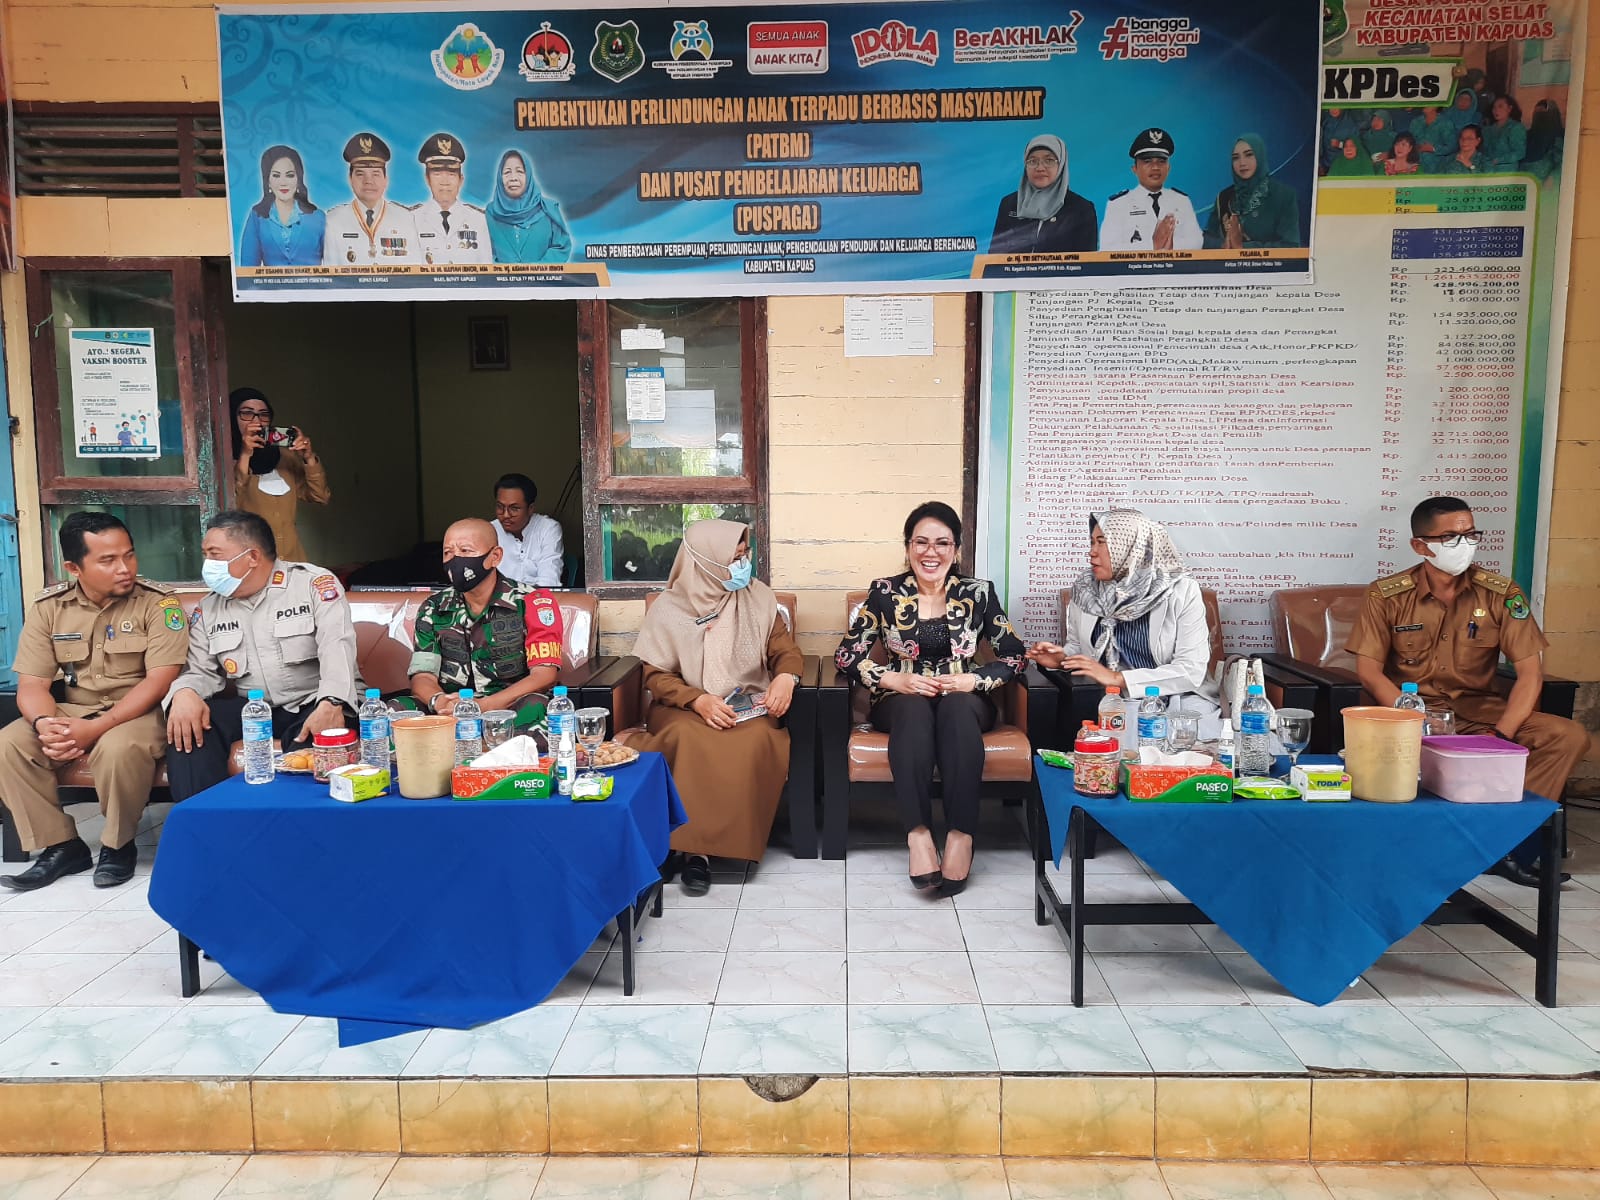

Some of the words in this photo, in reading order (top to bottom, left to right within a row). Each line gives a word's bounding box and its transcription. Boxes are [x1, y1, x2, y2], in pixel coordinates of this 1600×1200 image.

[1131, 18, 1188, 31] bangga
[1365, 8, 1482, 27] KECAMATAN
[1488, 4, 1547, 21] SELAT
[756, 31, 789, 42] SEMUA
[792, 30, 819, 40] ANAK
[853, 20, 937, 57] IDOLA
[955, 27, 1075, 46] BerAKHLAK
[1131, 30, 1199, 45] melayani
[1357, 27, 1471, 45] KABUPATEN
[1476, 22, 1554, 41] KAPUAS
[755, 53, 786, 65] ANAK
[789, 49, 822, 66] KITA!
[1131, 46, 1185, 61] bangsa
[518, 100, 628, 127] PEMBENTUKAN
[631, 97, 743, 125] PERLINDUNGAN
[747, 96, 787, 123] ANAK
[791, 94, 859, 121] TERPADU
[862, 92, 937, 119] BERBASIS
[941, 90, 1043, 118] MASYARAKAT
[747, 132, 810, 159] (PATBM)
[640, 172, 671, 197] DAN
[674, 170, 721, 197] PUSAT
[724, 167, 838, 196] PEMBELAJARAN
[842, 165, 919, 193] KELUARGA
[737, 204, 818, 232] (PUSPAGA)
[586, 245, 607, 258] DINAS
[609, 244, 662, 257] PEMBERDAYAAN
[664, 243, 708, 258] PEREMPUAN,
[710, 242, 762, 256] PERLINDUNGAN
[764, 241, 785, 256] ANAK,
[786, 240, 838, 253] PENGENDALIAN
[841, 239, 878, 252] PENDUDUK
[880, 239, 894, 251] DAN
[896, 239, 932, 251] KELUARGA
[934, 238, 976, 251] BERENCANA
[745, 260, 785, 273] KABUPATEN
[787, 259, 814, 271] KAPUAS
[277, 604, 311, 619] POLRI
[514, 779, 545, 789] PASEO
[1196, 782, 1229, 792] PASEO
